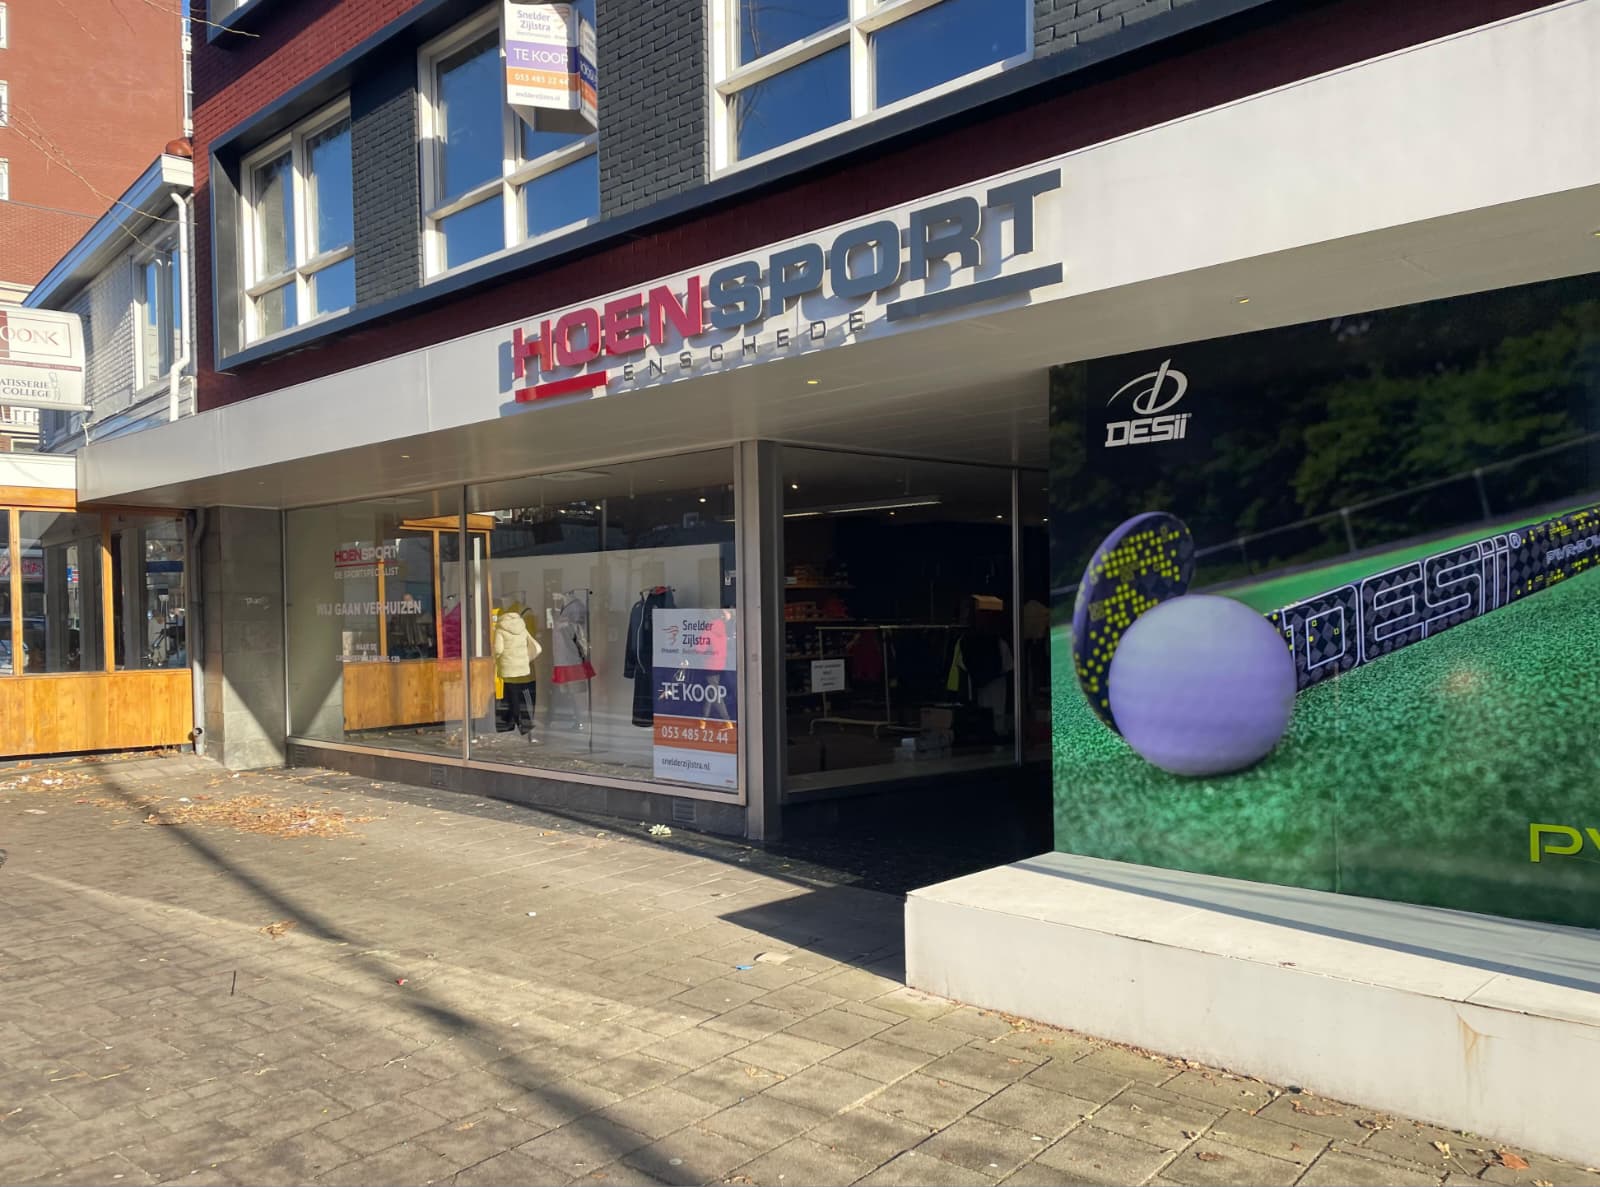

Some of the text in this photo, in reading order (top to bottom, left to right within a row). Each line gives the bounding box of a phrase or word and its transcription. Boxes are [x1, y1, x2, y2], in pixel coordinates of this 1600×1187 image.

[513, 47, 529, 61] TE
[623, 310, 867, 382] ENSCHEDE
[2, 386, 49, 399] COLLEGE
[335, 602, 360, 615] GAAN
[362, 600, 422, 615] VERHUIZEN
[682, 619, 713, 631] Snelder
[682, 634, 711, 647] Zijlstra
[662, 682, 727, 703] TE KOOP
[661, 725, 729, 744] 053 485 22 44
[661, 757, 711, 771] snelderzijlstra.nl
